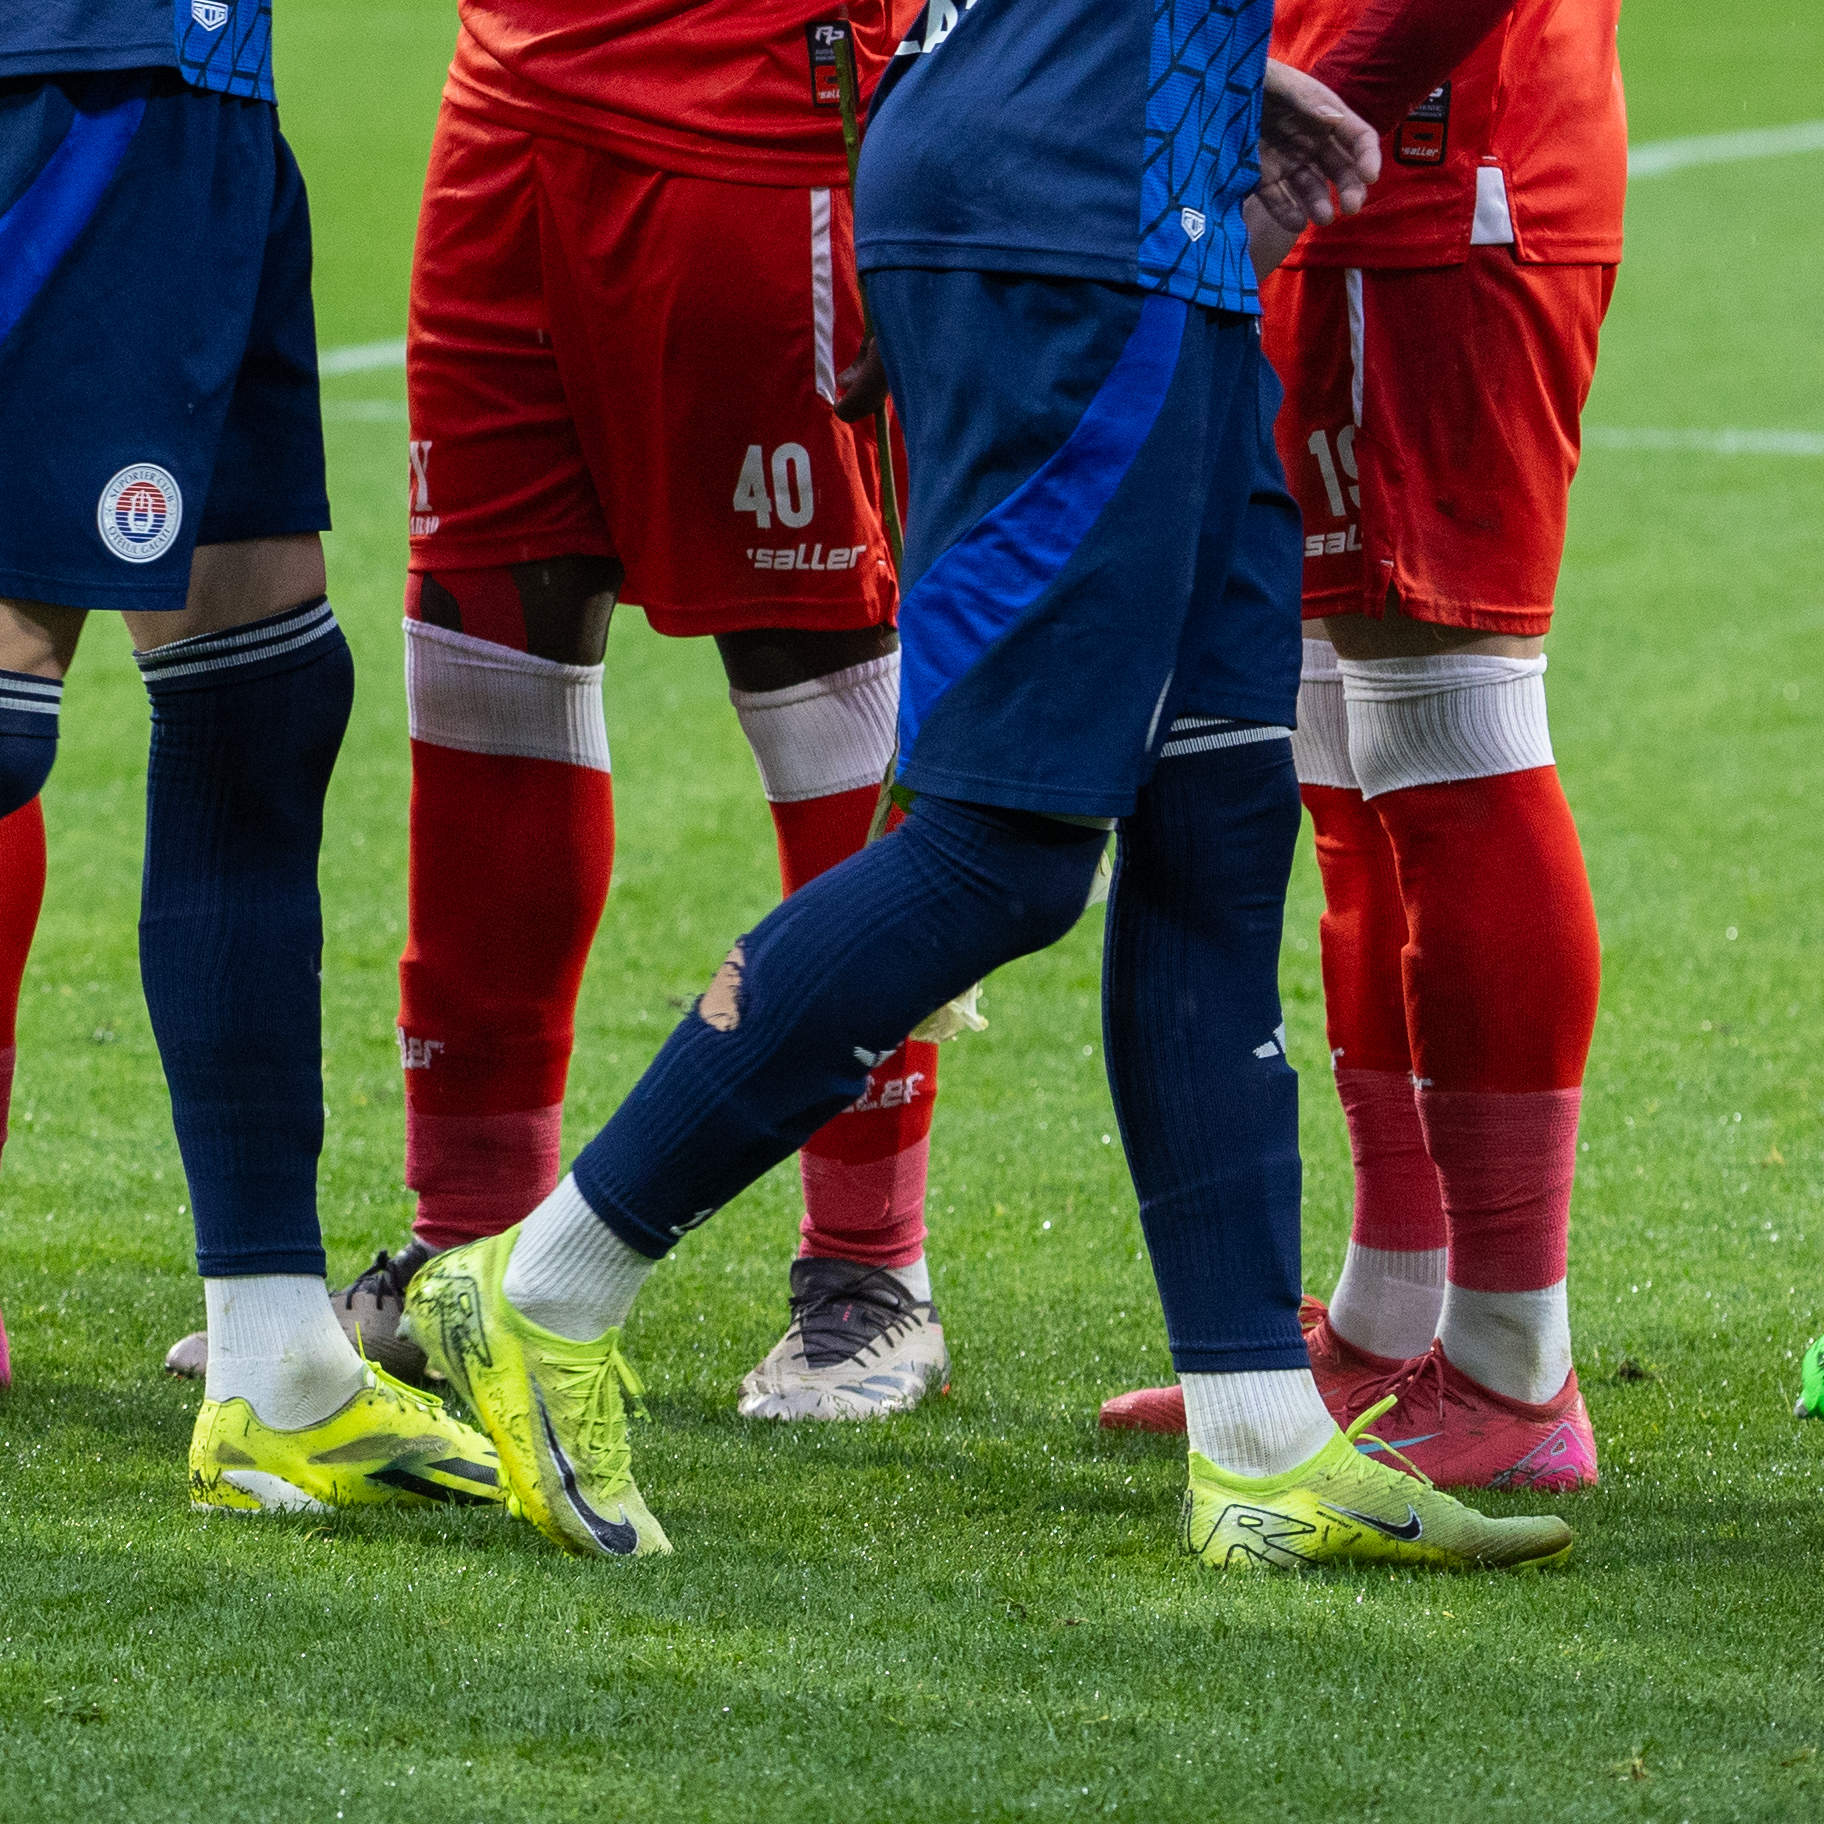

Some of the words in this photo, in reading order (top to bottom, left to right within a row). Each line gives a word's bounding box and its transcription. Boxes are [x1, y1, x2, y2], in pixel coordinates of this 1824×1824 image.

[111, 471, 156, 499] SUPORTER
[733, 442, 814, 528] 40
[754, 543, 867, 571] saller
